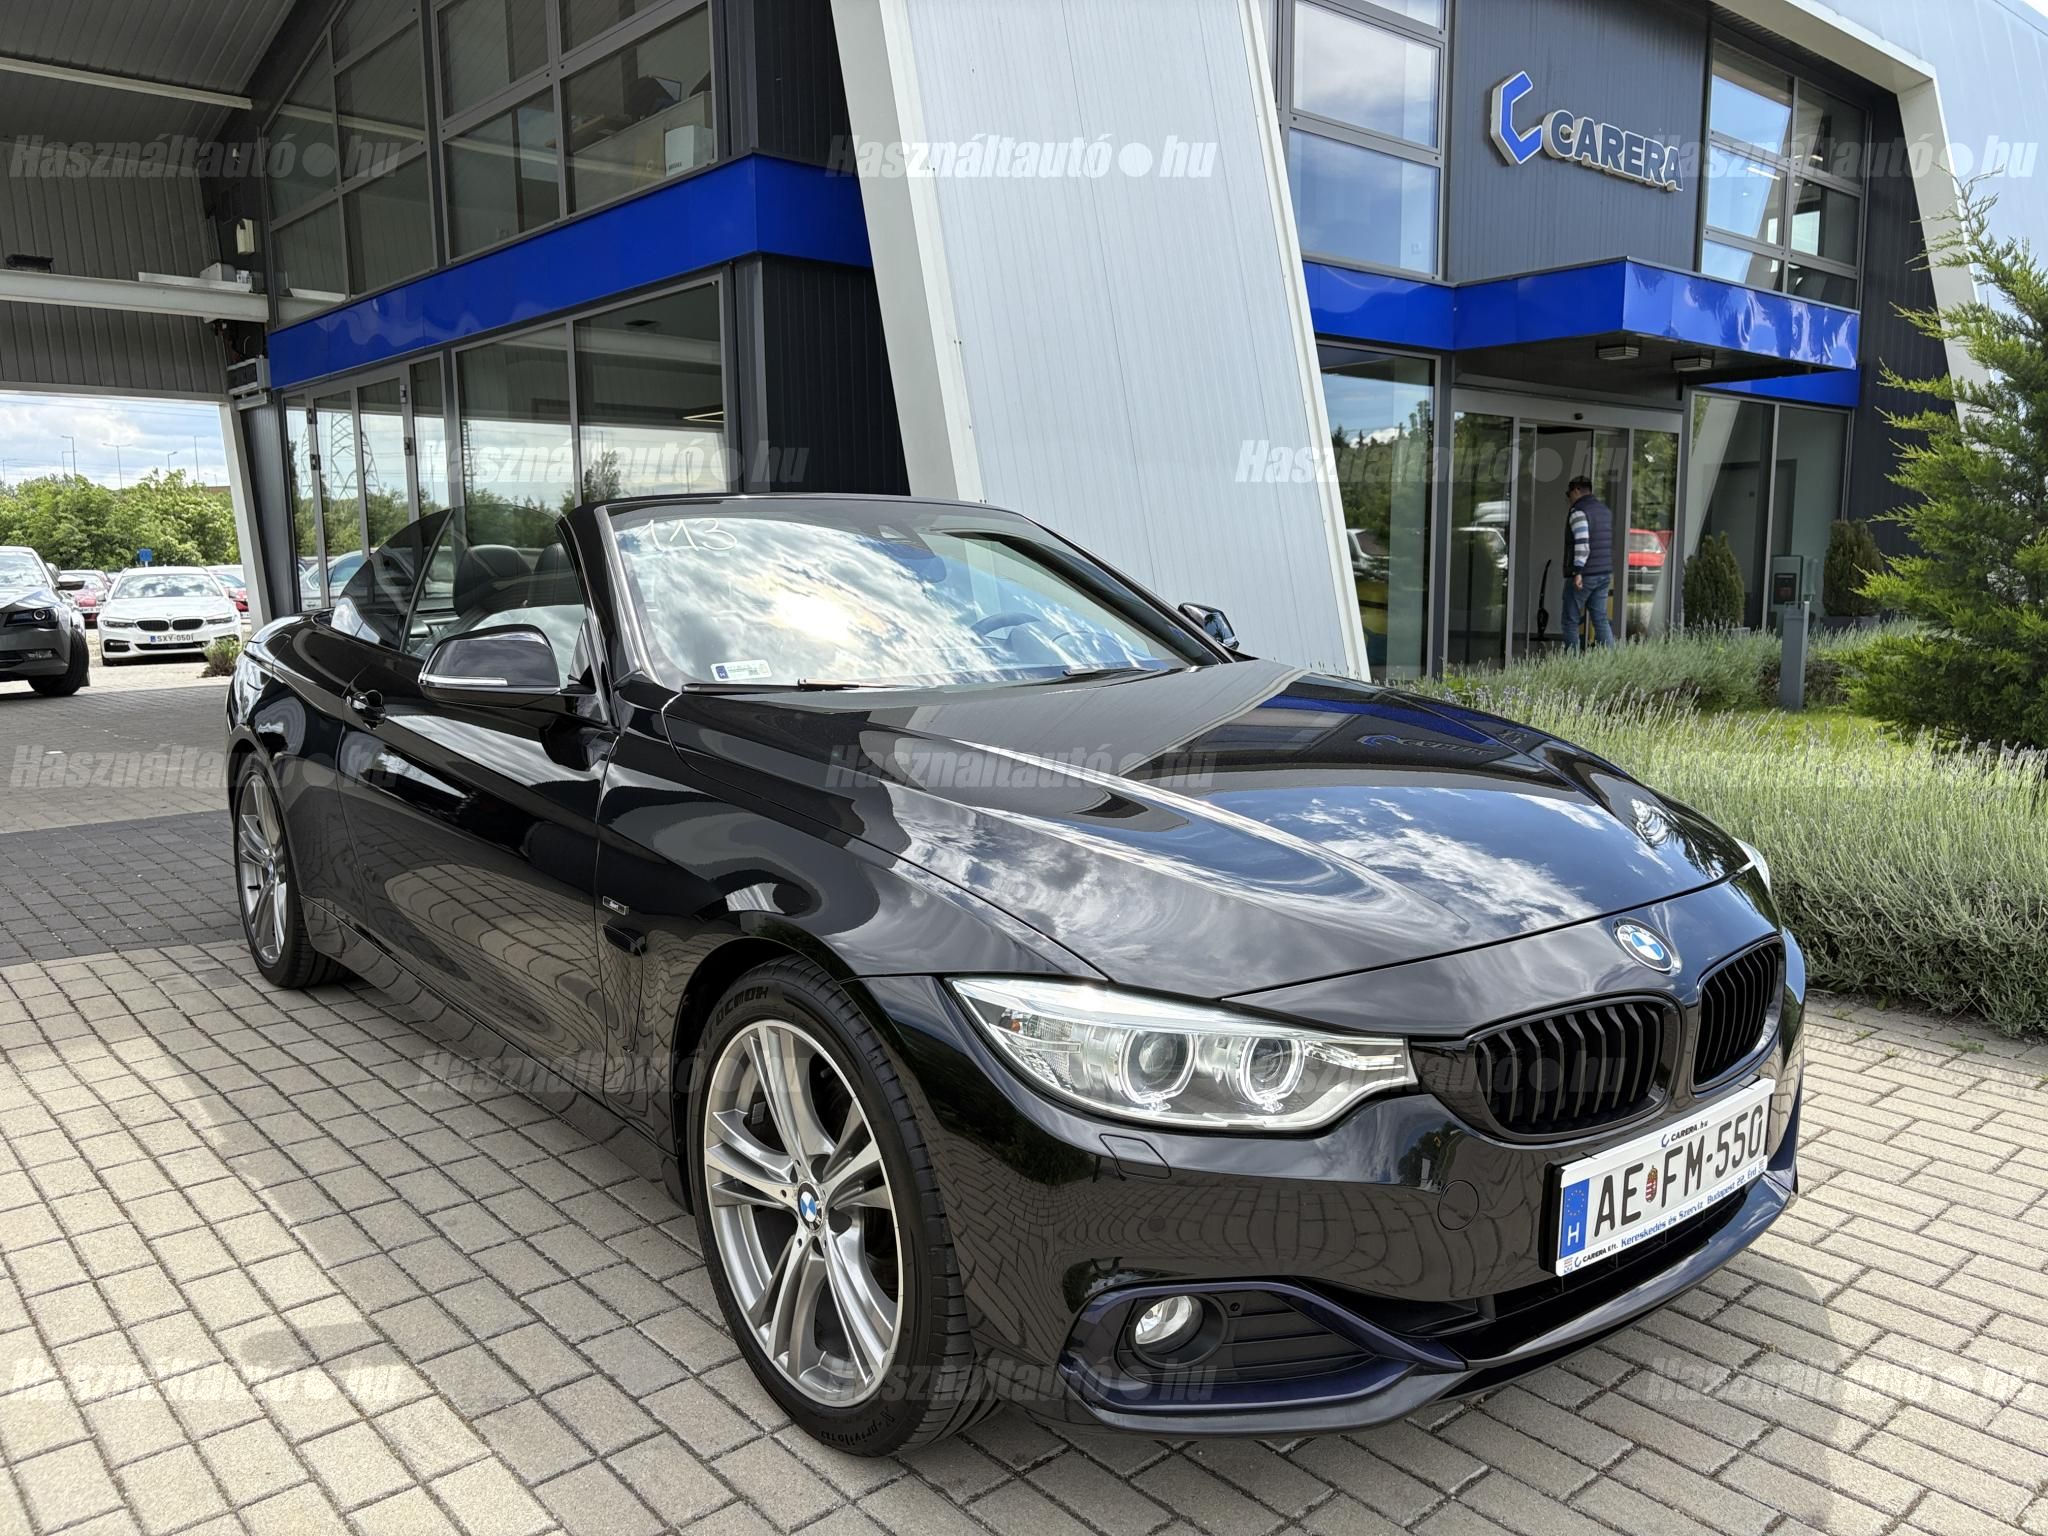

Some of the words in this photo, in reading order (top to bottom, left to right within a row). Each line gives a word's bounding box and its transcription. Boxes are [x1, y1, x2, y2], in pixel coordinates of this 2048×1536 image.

[1546, 109, 1684, 192] CARERA
[1593, 1162, 1644, 1238] AE
[1661, 1104, 1763, 1208] FM-550
[1566, 1221, 1580, 1247] H
[1582, 1247, 1607, 1263] CARERA
[1621, 1220, 1667, 1248] Kereskedés
[1668, 1215, 1677, 1226] és
[1678, 1202, 1703, 1219] Szerviz
[1706, 1182, 1735, 1205] Budapest
